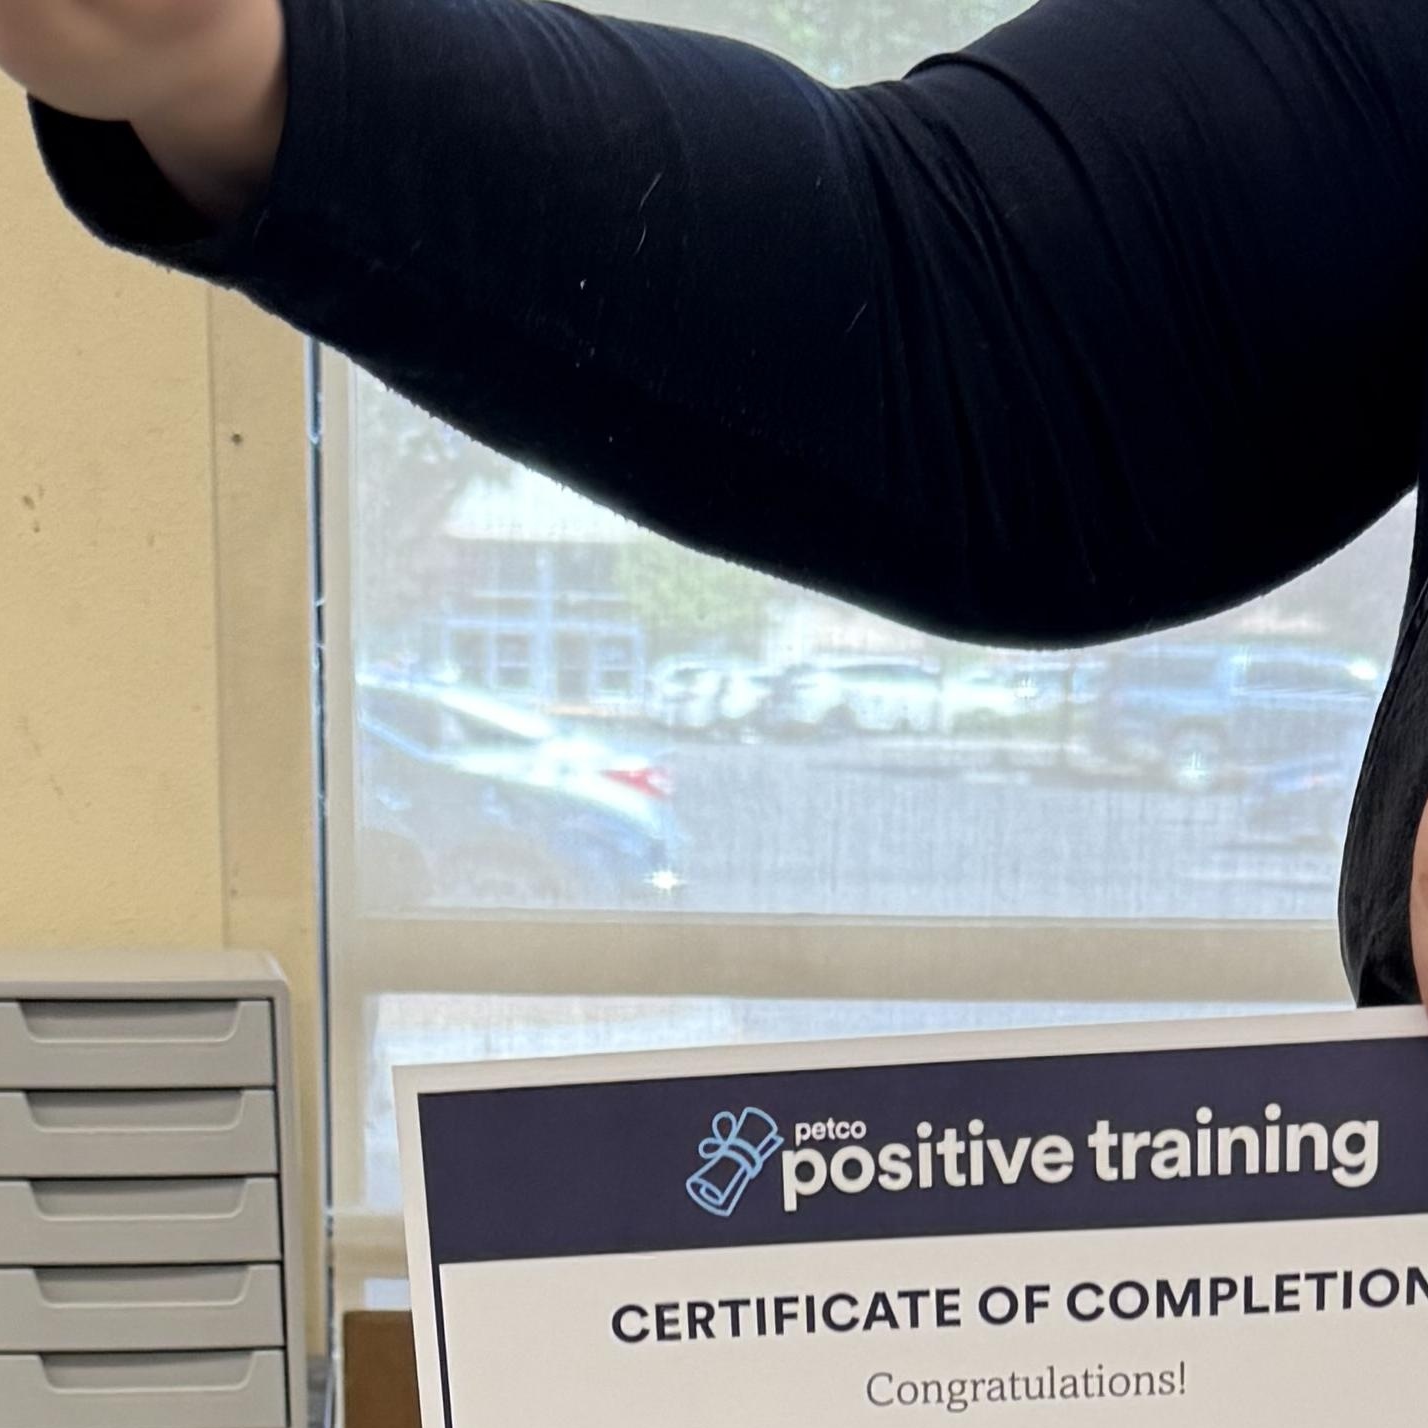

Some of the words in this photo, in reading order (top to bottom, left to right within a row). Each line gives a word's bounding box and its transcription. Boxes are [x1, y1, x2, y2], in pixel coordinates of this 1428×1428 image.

[781, 1118, 1075, 1212] positive
[1087, 1102, 1380, 1188] training
[794, 1117, 868, 1146] petco
[611, 1287, 962, 1343] CERTIFICATE
[978, 1284, 1052, 1326] OF
[865, 1361, 1188, 1412] Congratulations!
